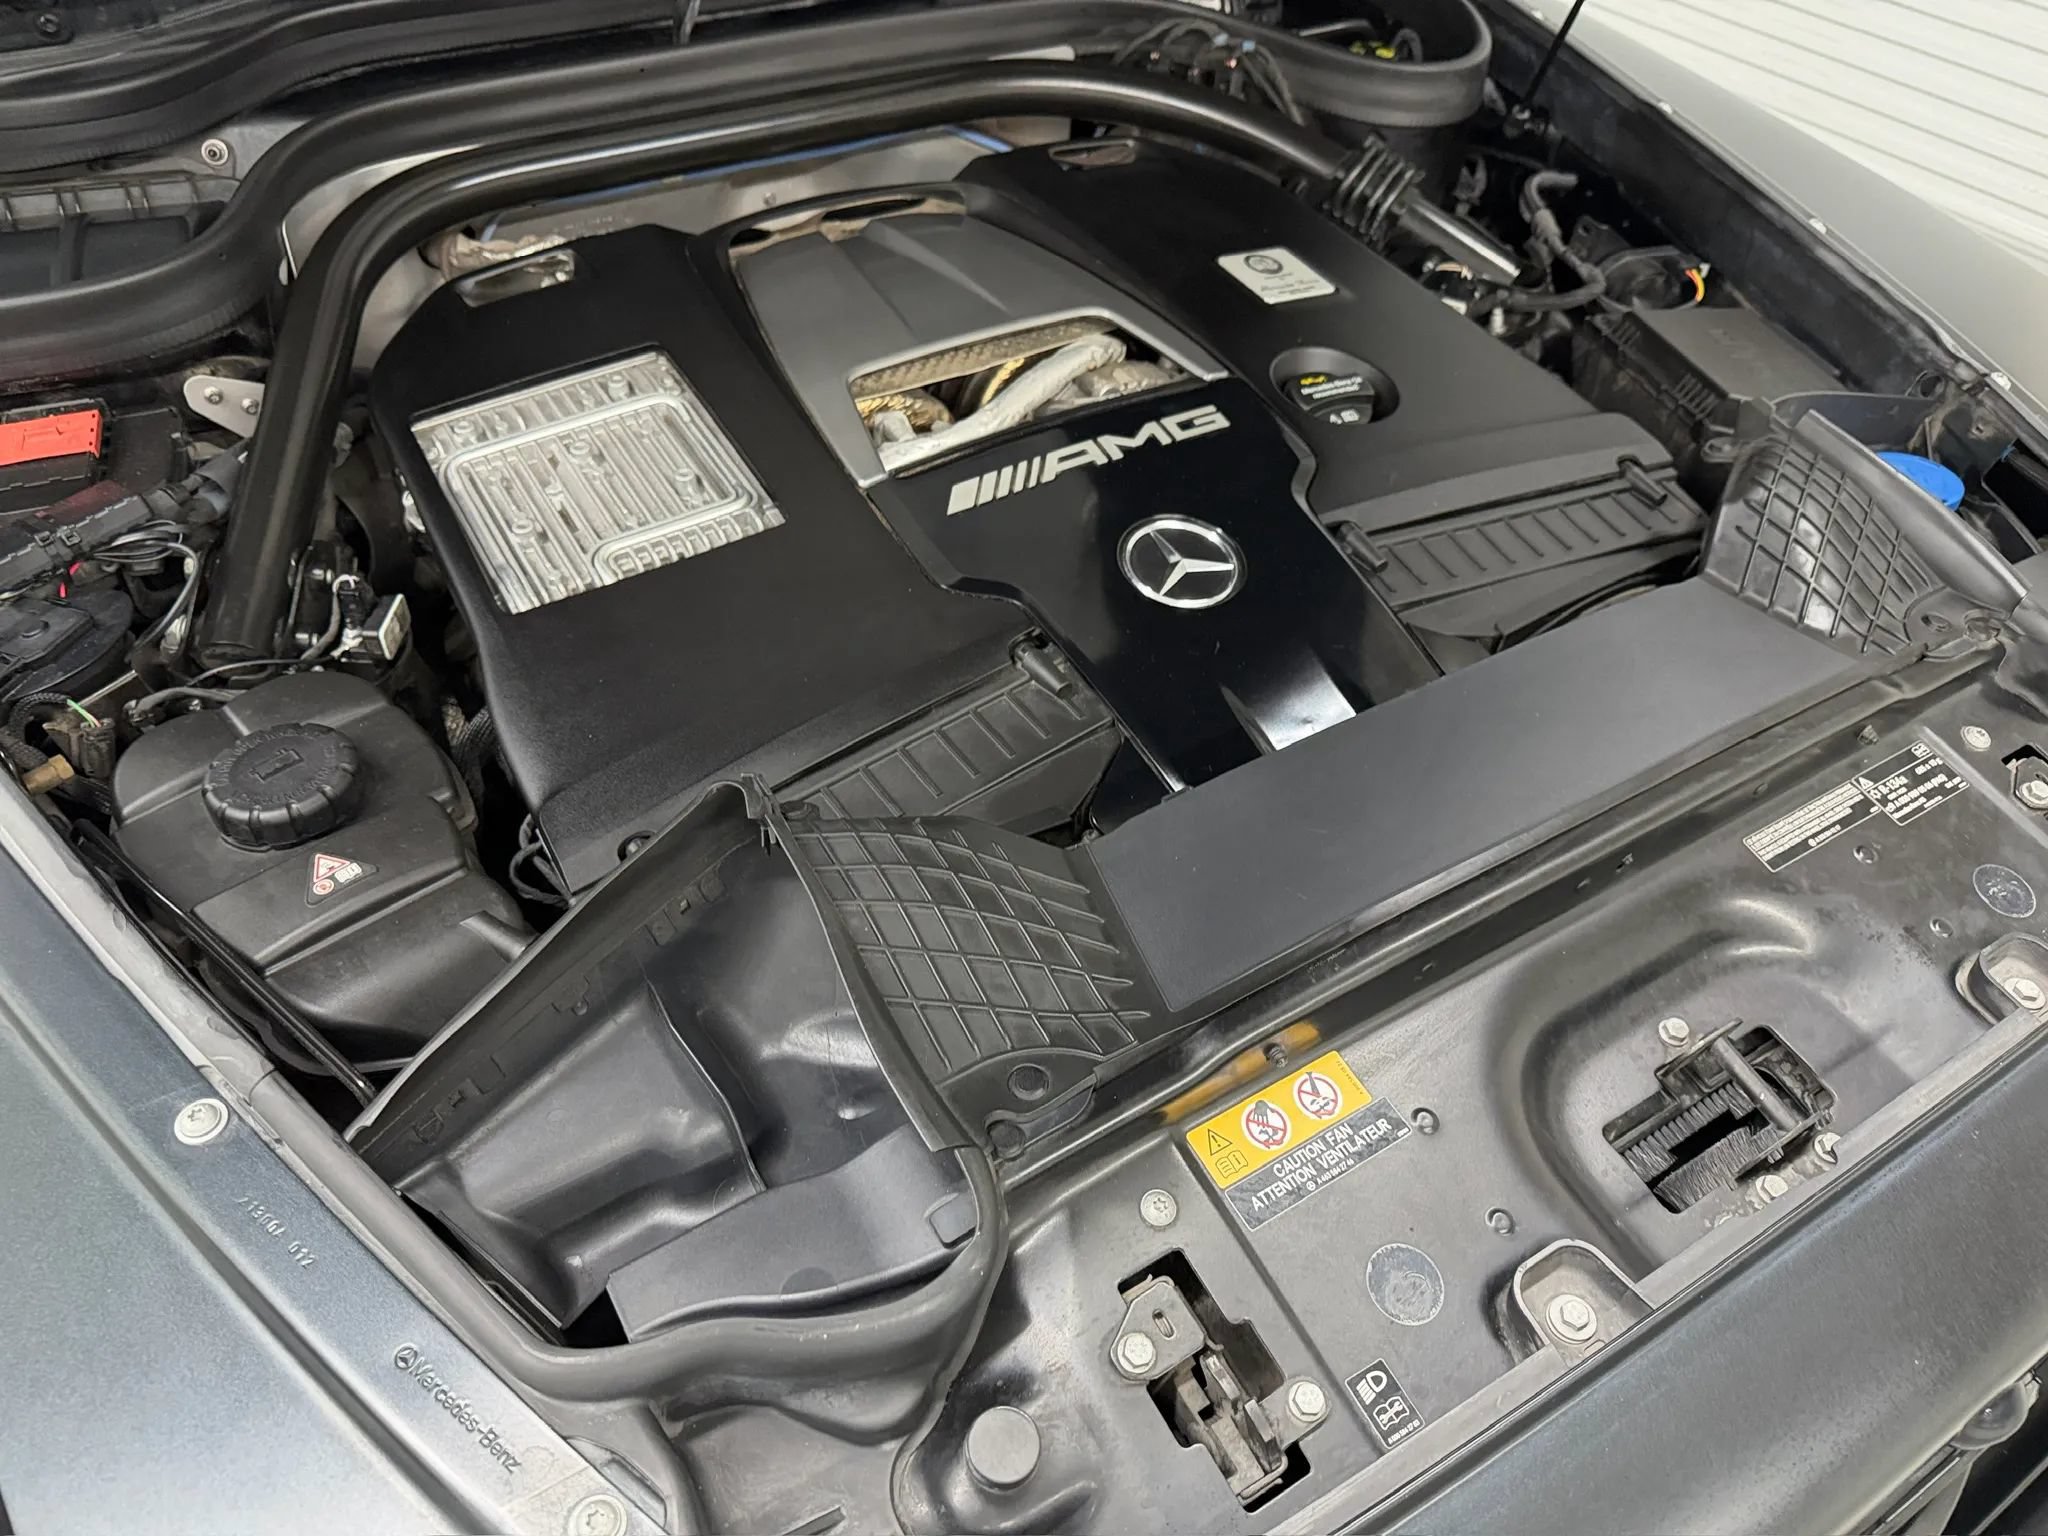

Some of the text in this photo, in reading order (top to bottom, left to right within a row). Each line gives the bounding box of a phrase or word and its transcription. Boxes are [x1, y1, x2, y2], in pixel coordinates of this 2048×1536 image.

[1040, 404, 1231, 484] AMG
[1251, 1118, 1392, 1212] ATTENTION VENTILATEUR
[1273, 1122, 1354, 1178] CAUTION FAN
[408, 1357, 522, 1474] Mercedes-Benz
